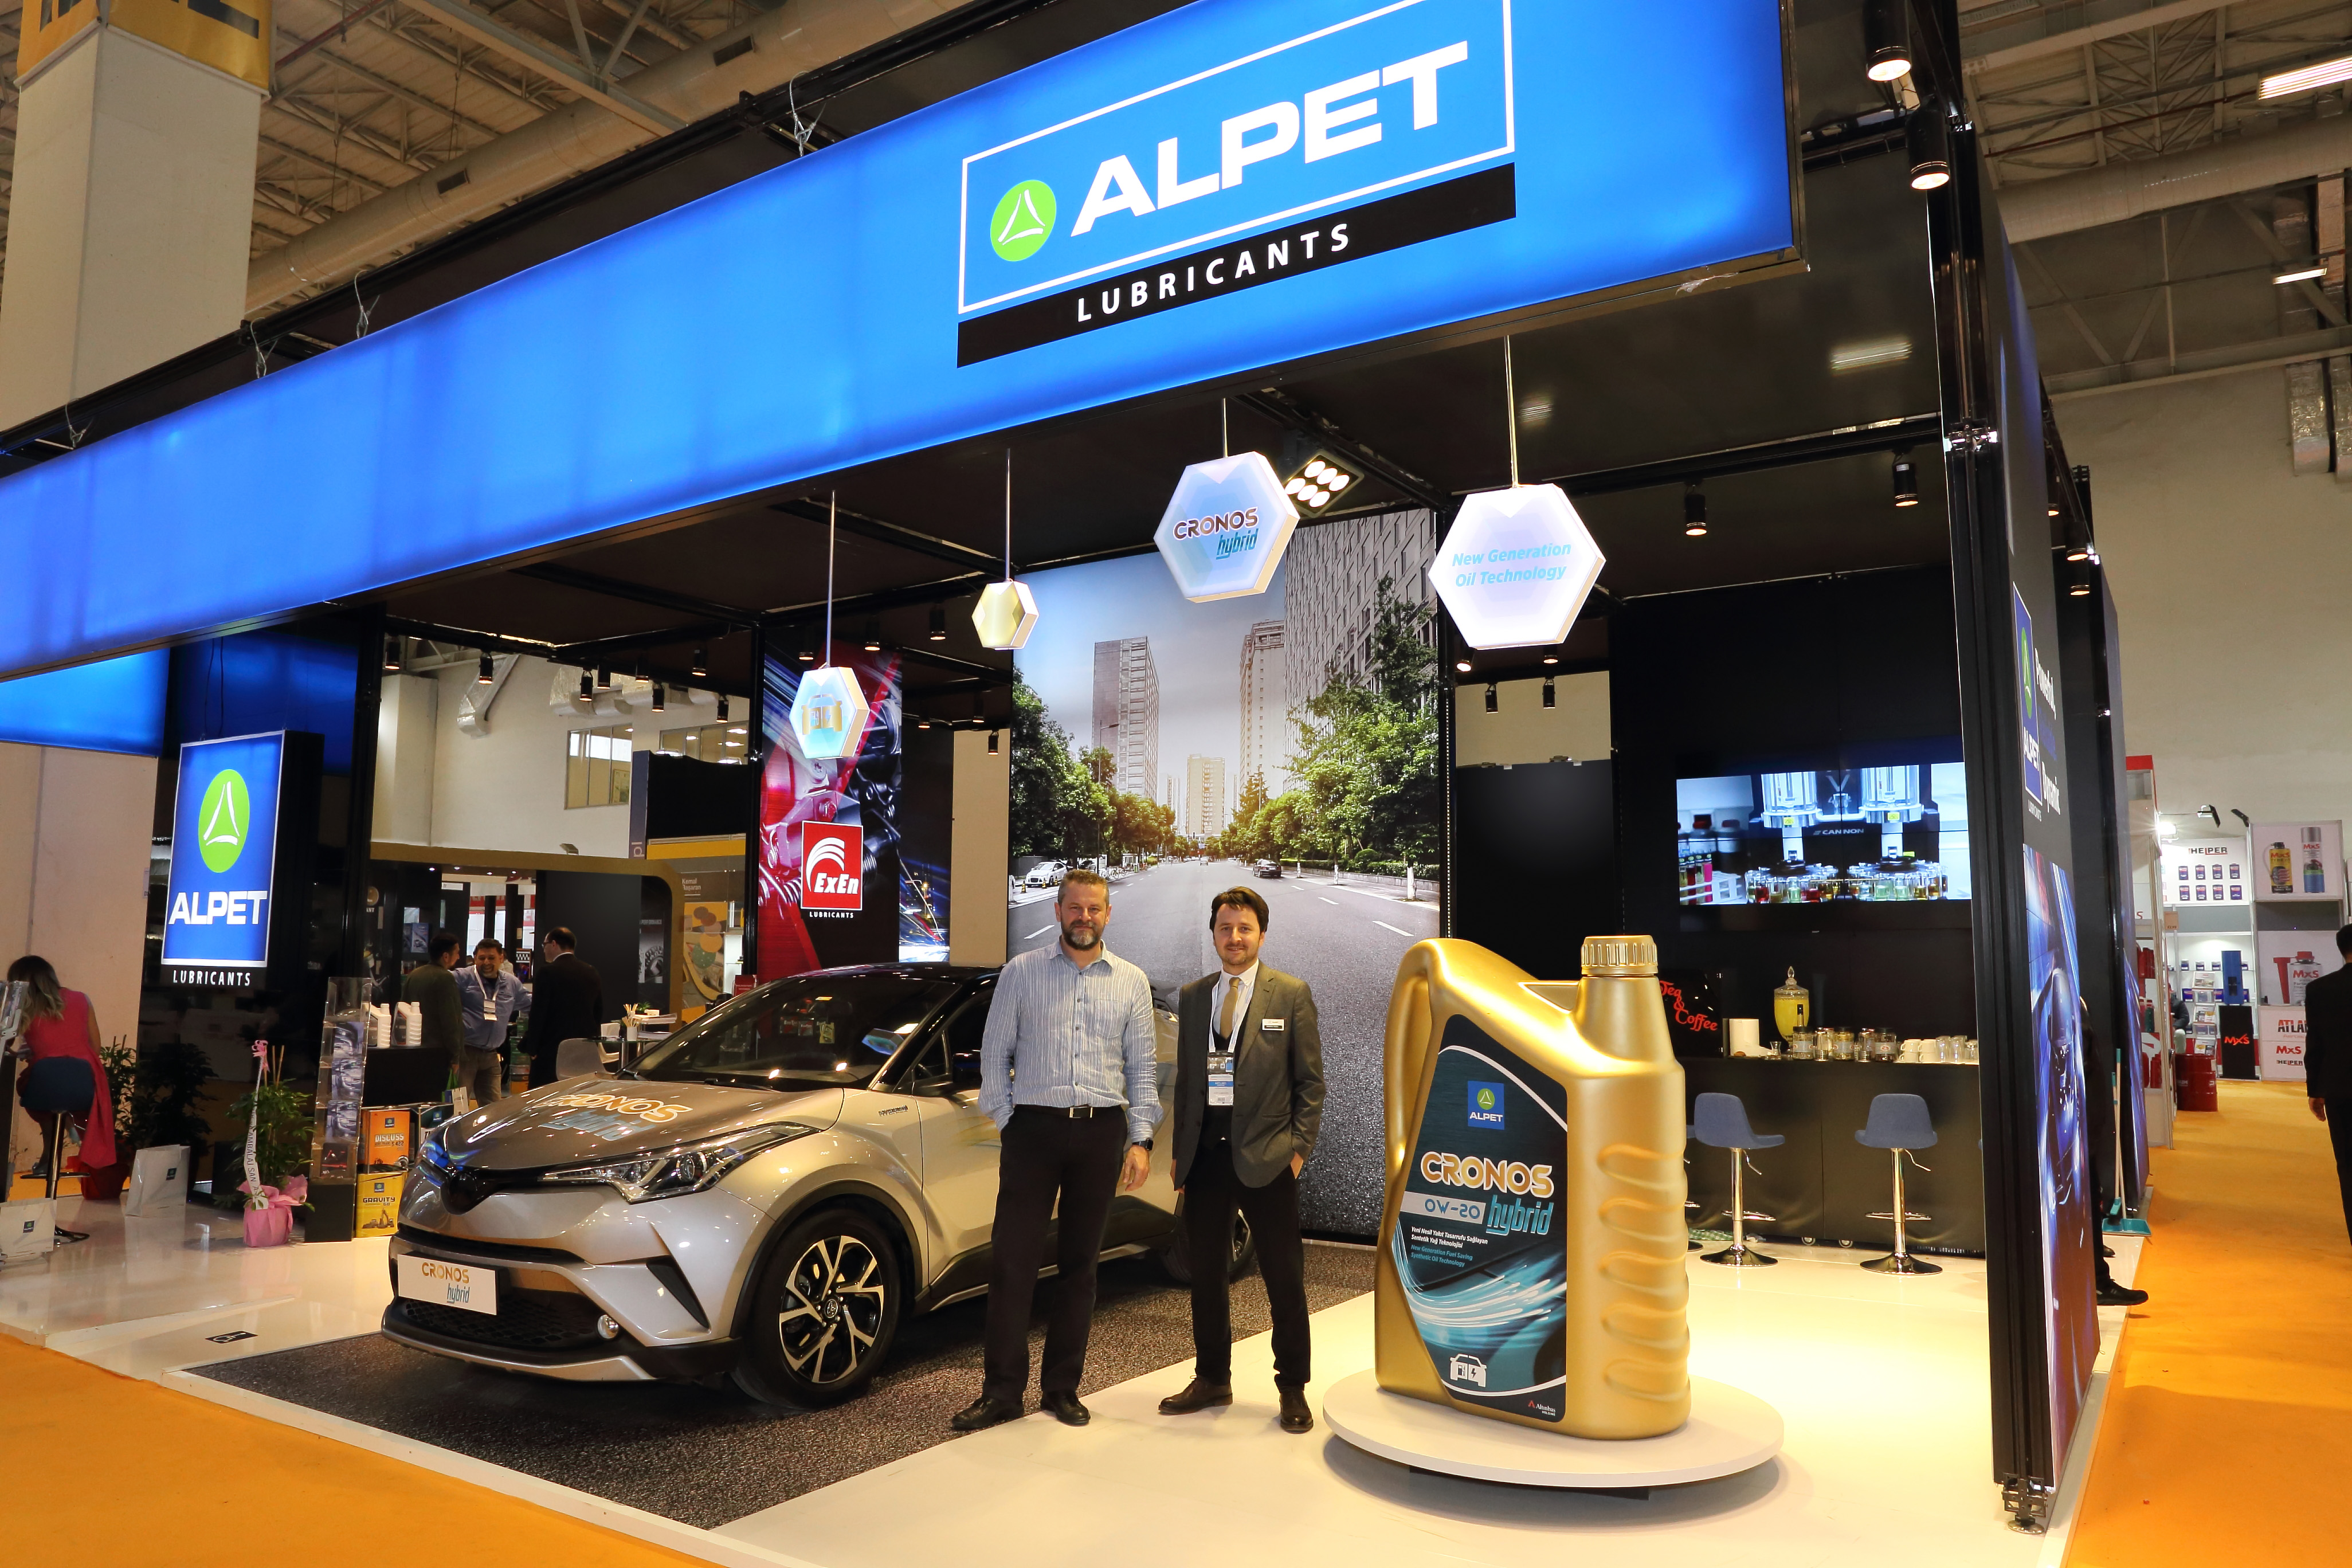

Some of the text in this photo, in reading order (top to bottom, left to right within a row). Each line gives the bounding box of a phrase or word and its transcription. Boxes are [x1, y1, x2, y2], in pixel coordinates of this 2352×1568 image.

[1071, 41, 1468, 237] ALPET
[1077, 223, 1349, 322] LUBRICANTS
[1173, 507, 1259, 540] CRONOS
[1216, 528, 1259, 560] hybrid
[1452, 543, 1571, 566] New Generation
[1456, 566, 1567, 587] Oil Technology
[2024, 727, 2040, 771] ALPET
[2041, 761, 2061, 815] Dynamic
[814, 872, 859, 894] ExEn
[168, 891, 268, 924] ALPET
[173, 970, 250, 986] LUBRICANTS
[2293, 970, 2319, 978] MxS
[1675, 1010, 1718, 1032] Coffee
[2276, 1045, 2302, 1054] MxS
[530, 1093, 693, 1123] CRONOS
[1469, 1112, 1503, 1122] ALPET
[375, 1133, 405, 1142] DISCUSS
[248, 1168, 257, 1182] SAN
[1421, 1151, 1554, 1198] CRONOS
[1425, 1198, 1481, 1220] 0W-20
[1486, 1195, 1554, 1236] hybrid
[1411, 1234, 1464, 1248] Sentetik Yağ Teknolojisi
[1444, 1232, 1466, 1241] Tasarrufu
[1467, 1235, 1488, 1244] Sağlayan
[1411, 1252, 1431, 1261] Synthetic
[1439, 1257, 1465, 1267] Technology
[1421, 1246, 1445, 1255] Generation
[1457, 1253, 1473, 1261] Saving
[422, 1262, 470, 1284] CRONOS
[446, 1283, 470, 1304] hybrid
